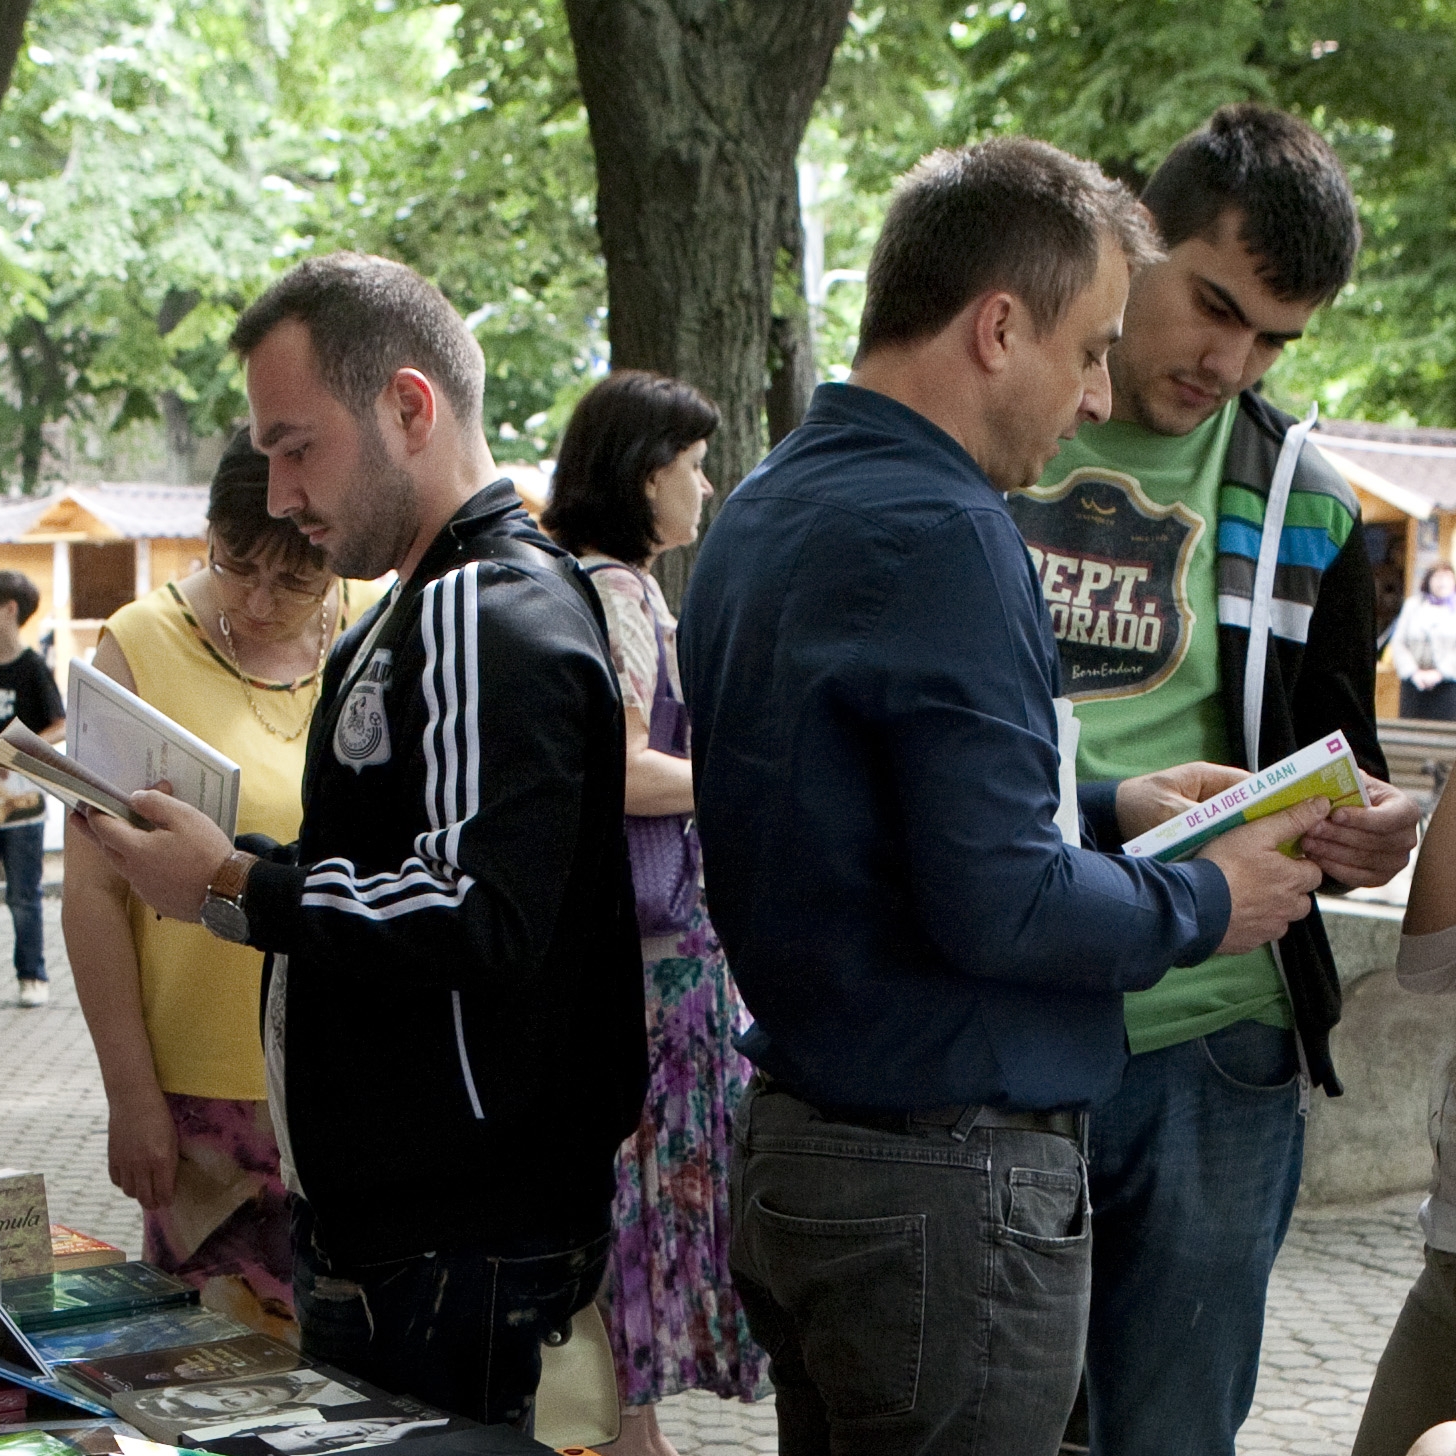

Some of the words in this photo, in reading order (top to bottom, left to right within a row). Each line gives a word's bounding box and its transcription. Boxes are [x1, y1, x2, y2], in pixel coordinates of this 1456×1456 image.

[1185, 810, 1202, 828] DE
[1203, 802, 1221, 819] LA
[1221, 789, 1250, 811] IDEE
[1249, 780, 1266, 796] LA
[1266, 762, 1297, 787] BANI
